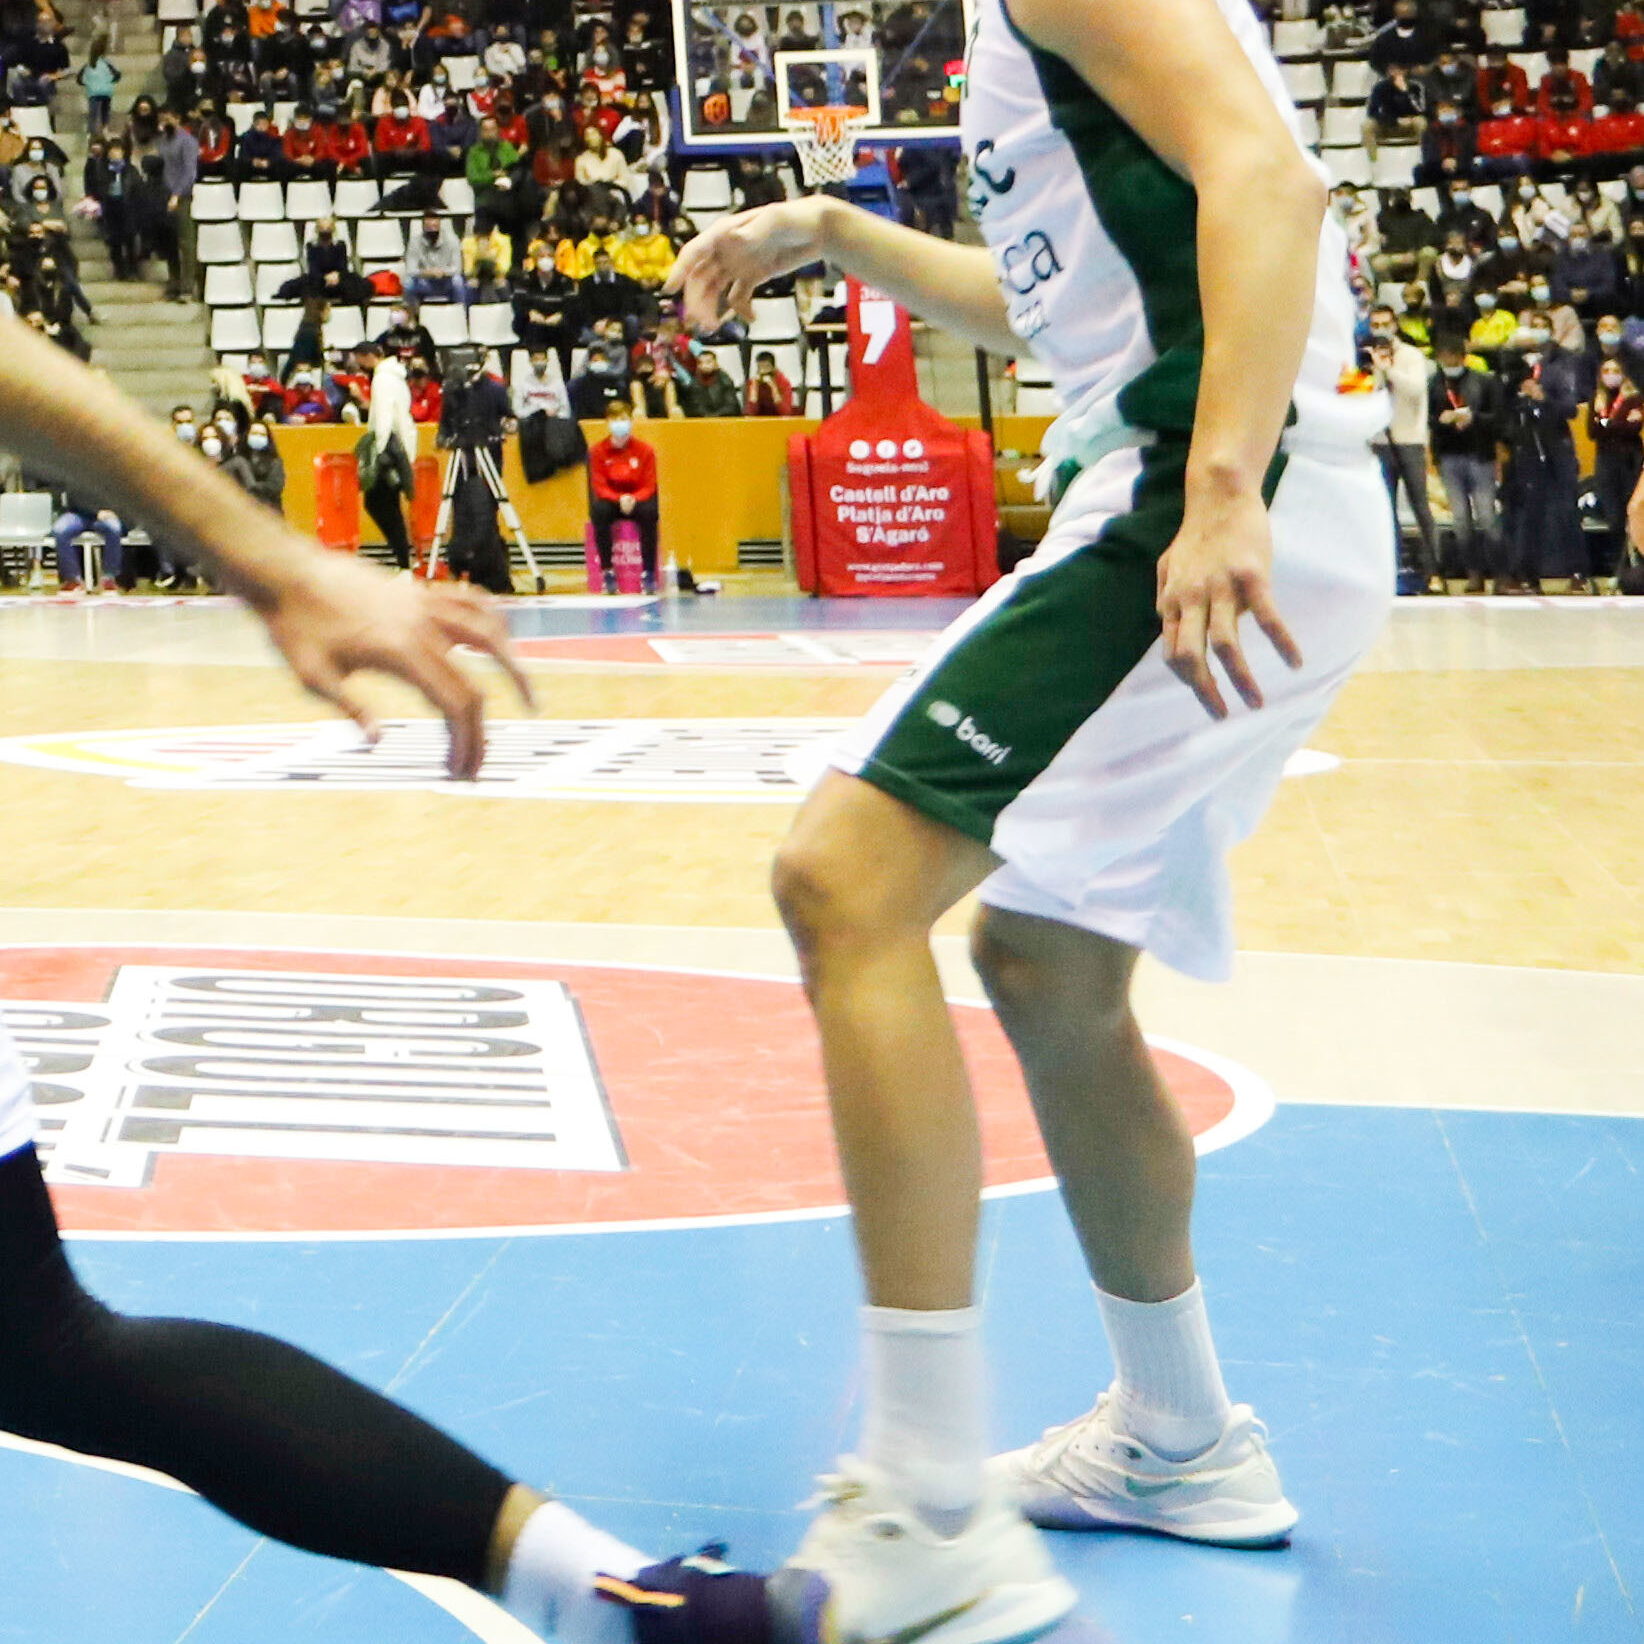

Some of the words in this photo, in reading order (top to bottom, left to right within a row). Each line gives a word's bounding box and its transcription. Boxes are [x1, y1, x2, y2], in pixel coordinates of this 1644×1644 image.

[829, 484, 897, 504] Castell
[899, 484, 950, 503] d'Aro
[837, 505, 893, 525] Platja
[895, 505, 946, 523] d'Aro
[855, 524, 931, 547] S'Agaró
[120, 972, 561, 1149] ORGULL
